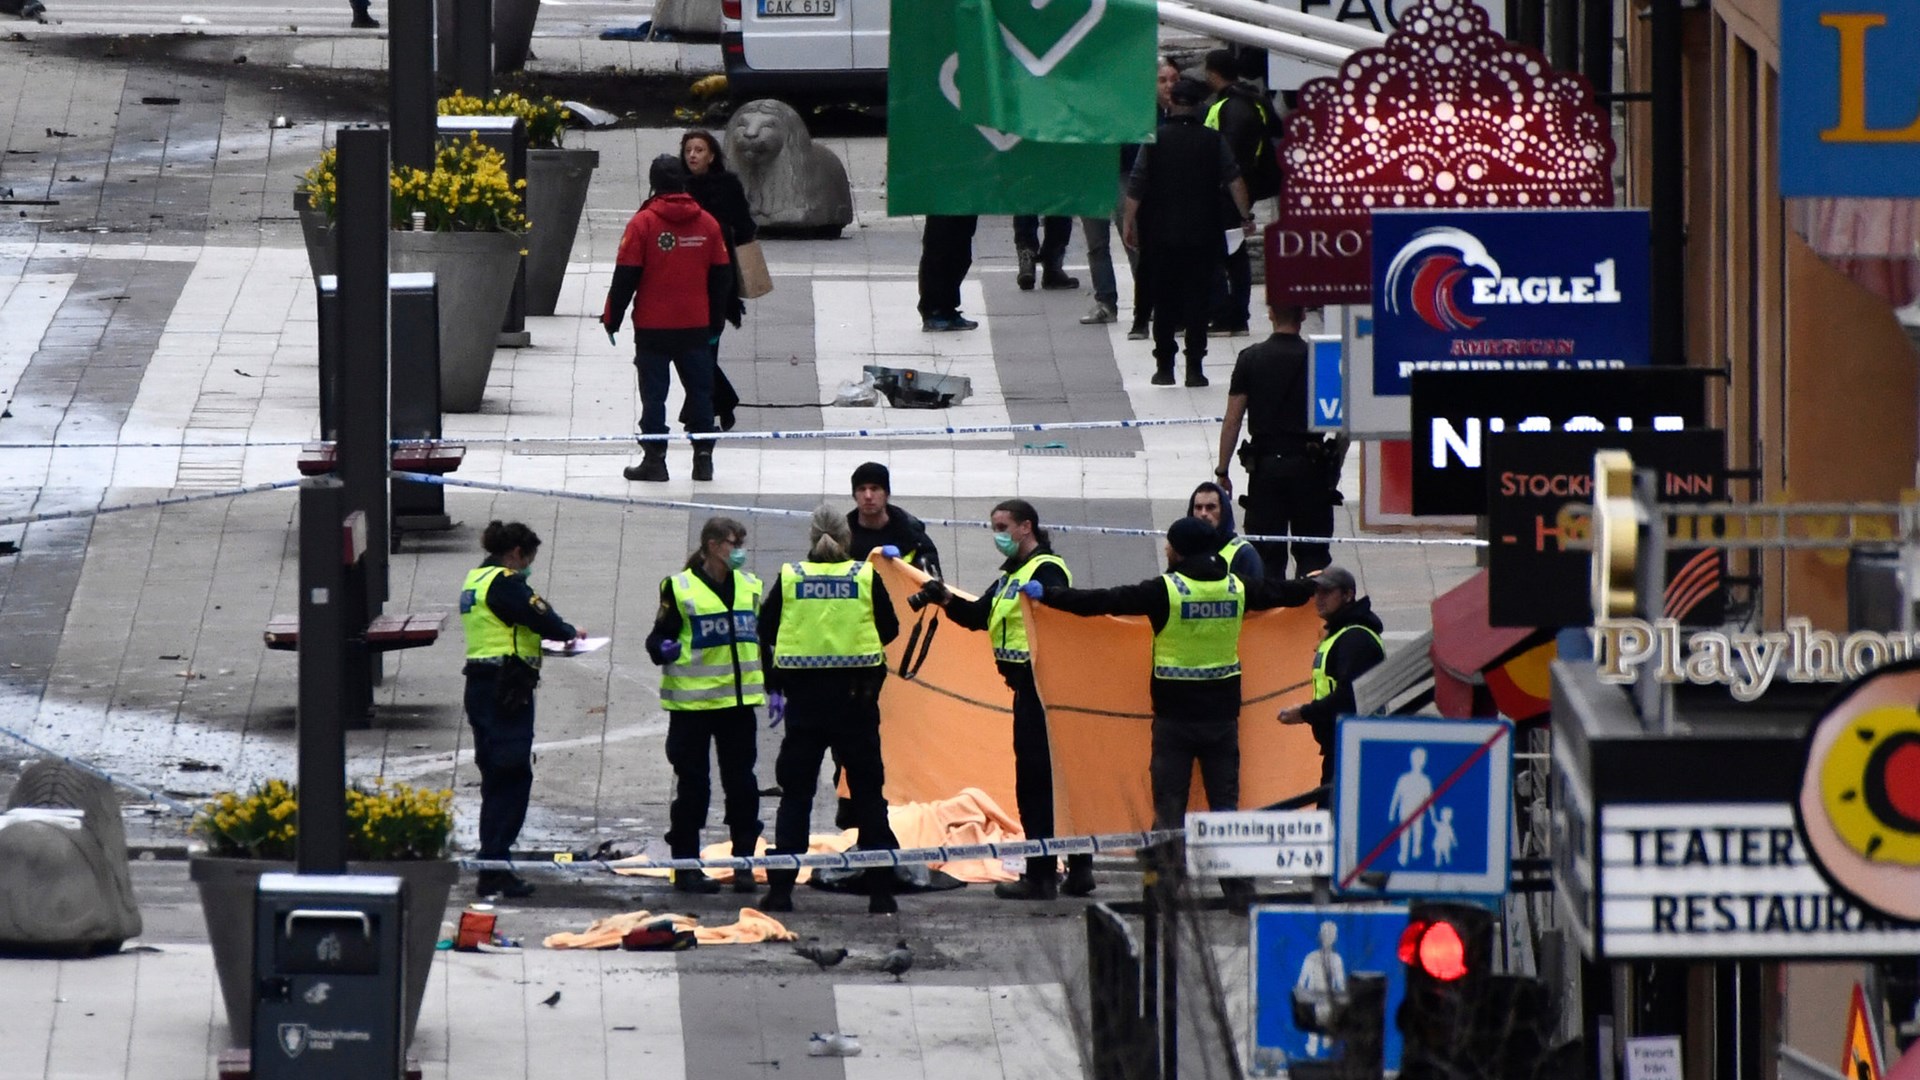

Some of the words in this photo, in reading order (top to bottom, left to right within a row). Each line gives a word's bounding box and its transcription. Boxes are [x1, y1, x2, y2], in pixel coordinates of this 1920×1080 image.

[766, 0, 793, 13] CAK
[803, 0, 832, 13] 619
[1279, 230, 1371, 258] DRO
[1472, 258, 1621, 304] EAGLE1
[1450, 338, 1575, 355] AMERICAN
[1501, 472, 1593, 497] STOCK
[1665, 472, 1713, 496] INN
[803, 583, 851, 598] POLIS
[1188, 602, 1232, 618] POLIS
[1627, 829, 1795, 867] TEATER
[1276, 849, 1323, 868] 67-69
